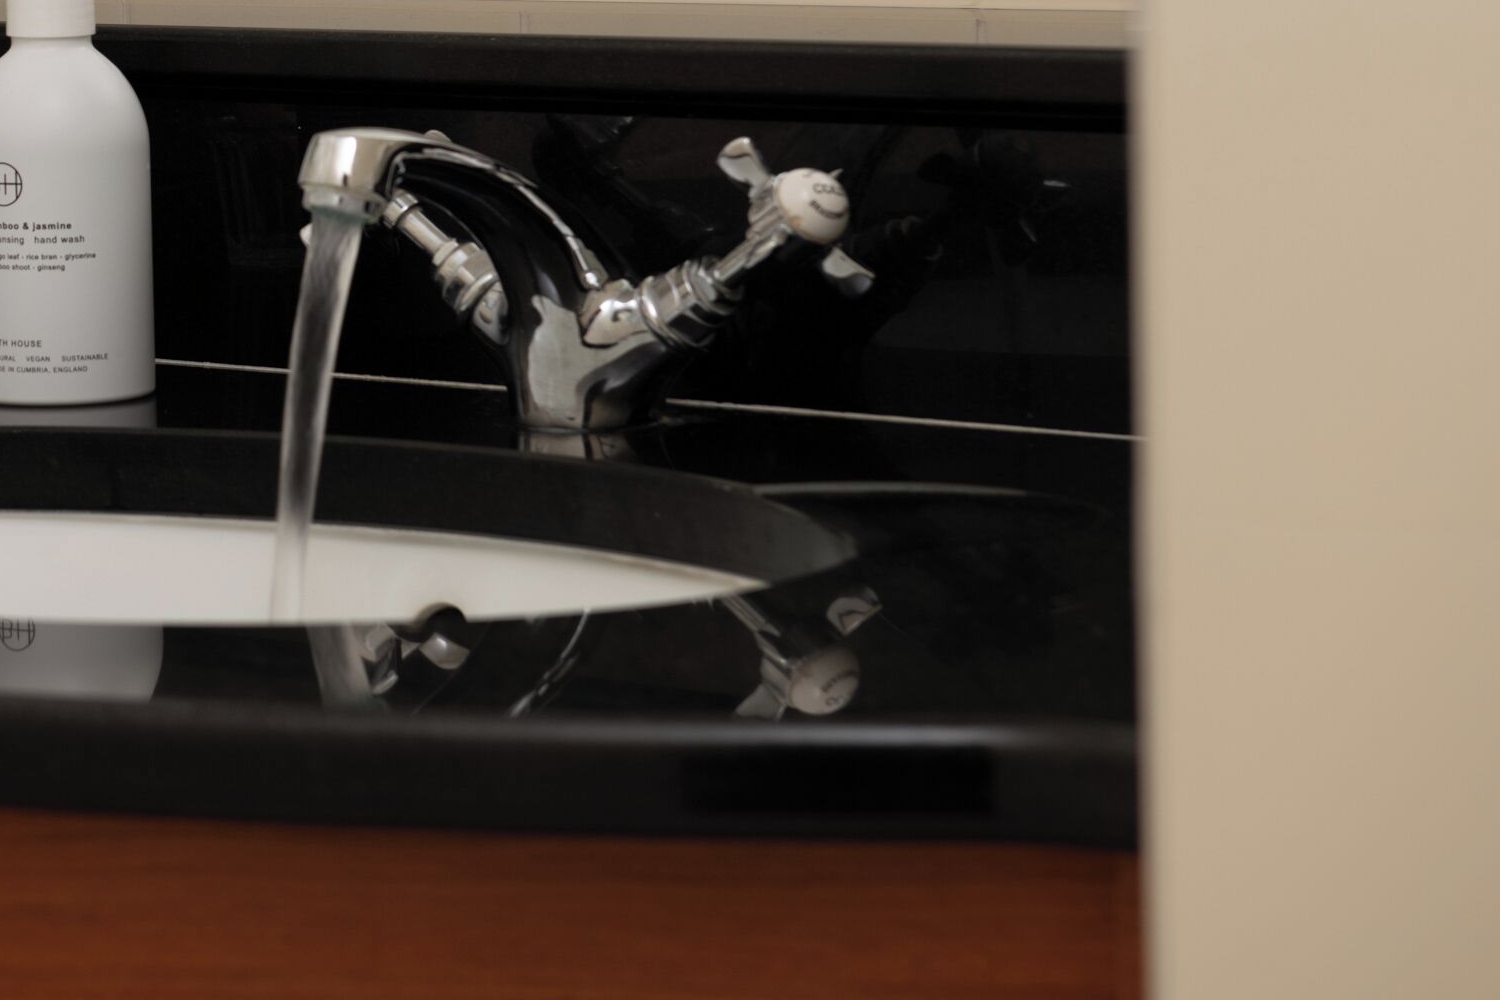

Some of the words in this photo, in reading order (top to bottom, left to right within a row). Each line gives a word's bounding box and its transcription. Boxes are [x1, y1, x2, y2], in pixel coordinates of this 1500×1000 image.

[22, 222, 29, 230] &
[32, 222, 72, 232] jasmine
[34, 236, 57, 244] hand
[61, 235, 85, 243] wash
[65, 252, 96, 261] glycerine
[37, 264, 66, 272] ginseng
[11, 339, 43, 348] HOUSE
[62, 353, 109, 362] SUSTAINABLE
